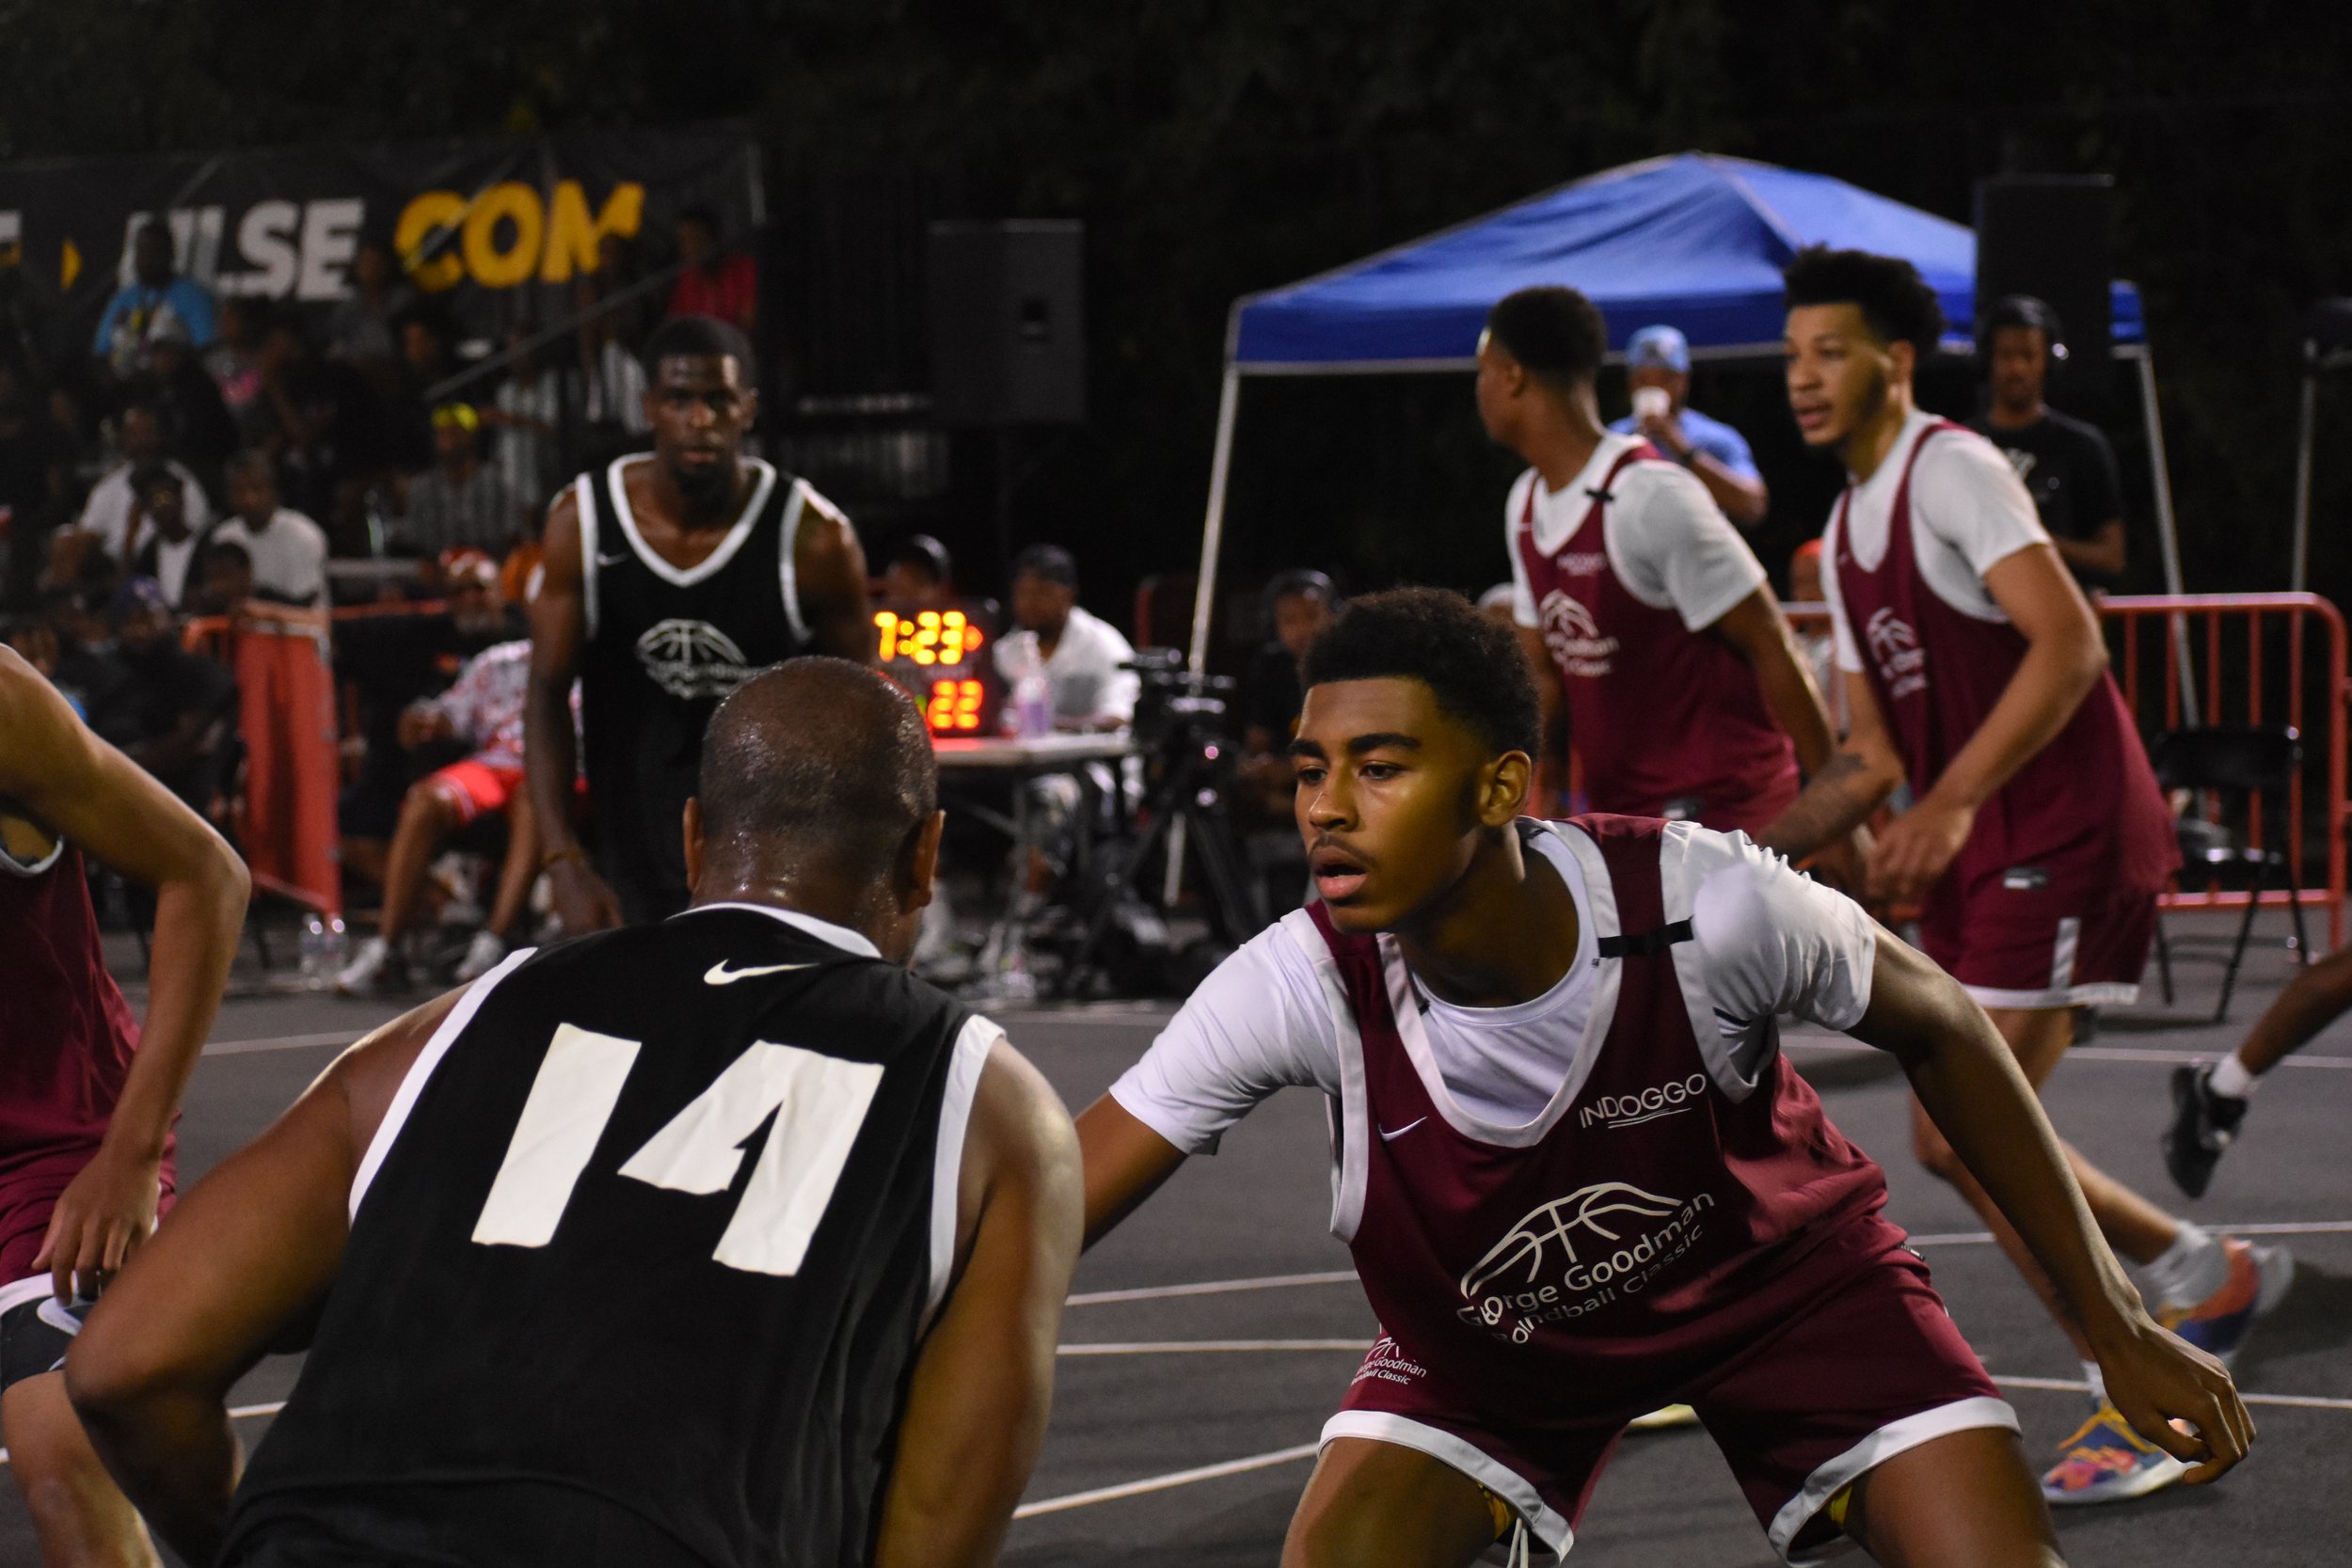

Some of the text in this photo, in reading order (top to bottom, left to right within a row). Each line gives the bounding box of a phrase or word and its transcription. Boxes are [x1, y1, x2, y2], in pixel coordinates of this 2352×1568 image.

[1580, 1073, 1707, 1128] INDOGGO
[471, 1022, 884, 1276] 14
[1565, 1193, 1714, 1291] Goodman
[1623, 1225, 1703, 1293] Classic
[1375, 1356, 1427, 1377] Goodman
[1377, 1370, 1411, 1385] Classic
